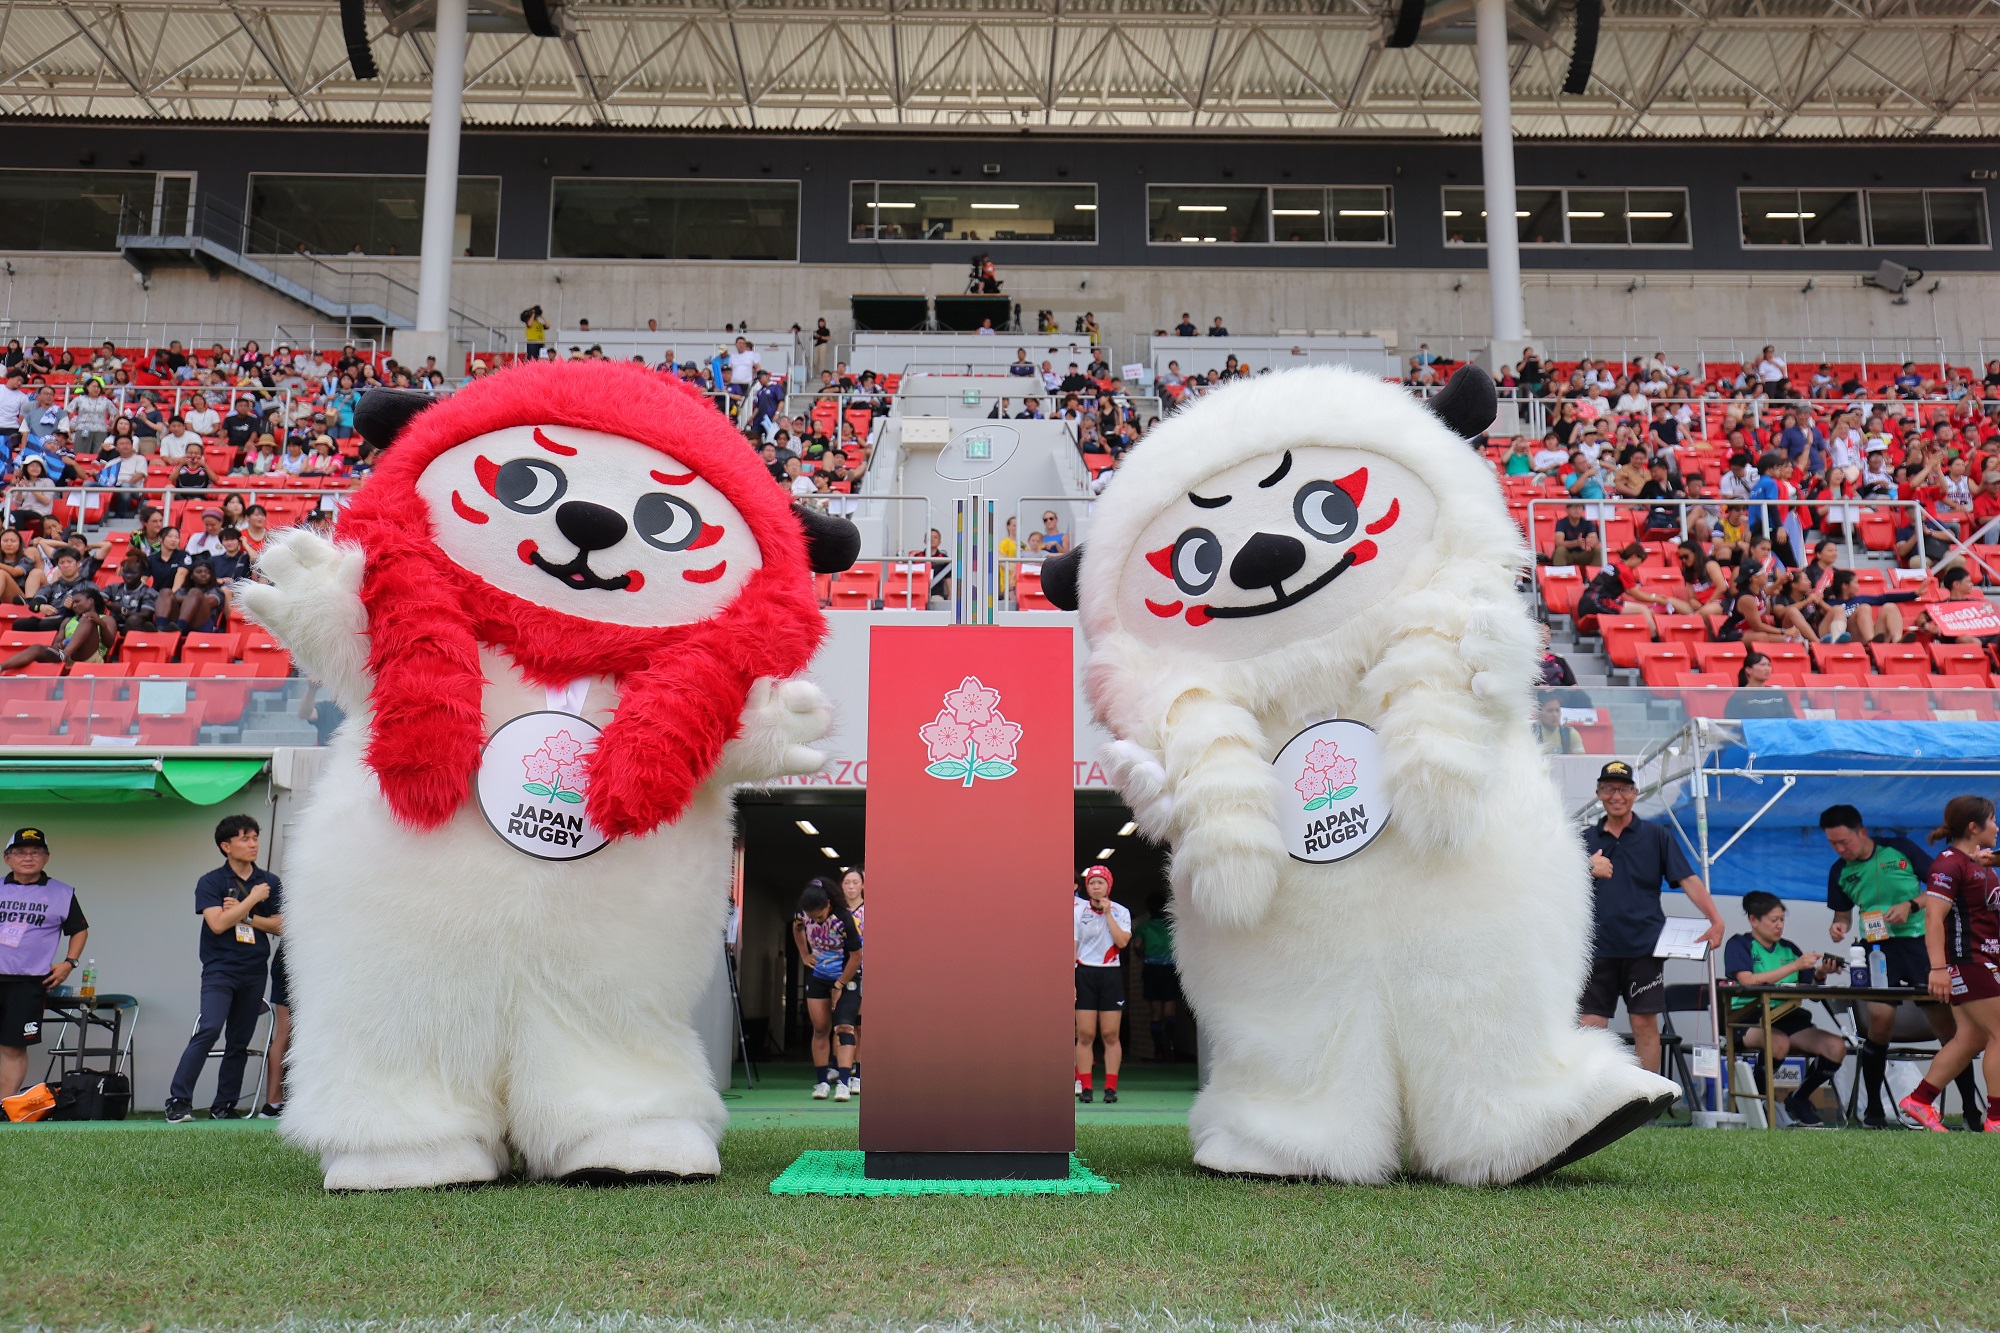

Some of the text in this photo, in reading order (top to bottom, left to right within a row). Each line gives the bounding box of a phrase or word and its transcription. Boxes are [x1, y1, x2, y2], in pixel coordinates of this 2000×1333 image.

[1073, 761, 1108, 785] TA
[510, 803, 583, 832] JAPAN
[1303, 804, 1365, 838] JAPAN
[507, 818, 584, 848] RUGBY
[1304, 818, 1369, 854] RUGBY
[0, 900, 49, 913] ATCH DAY
[0, 910, 46, 927] OCTOR
